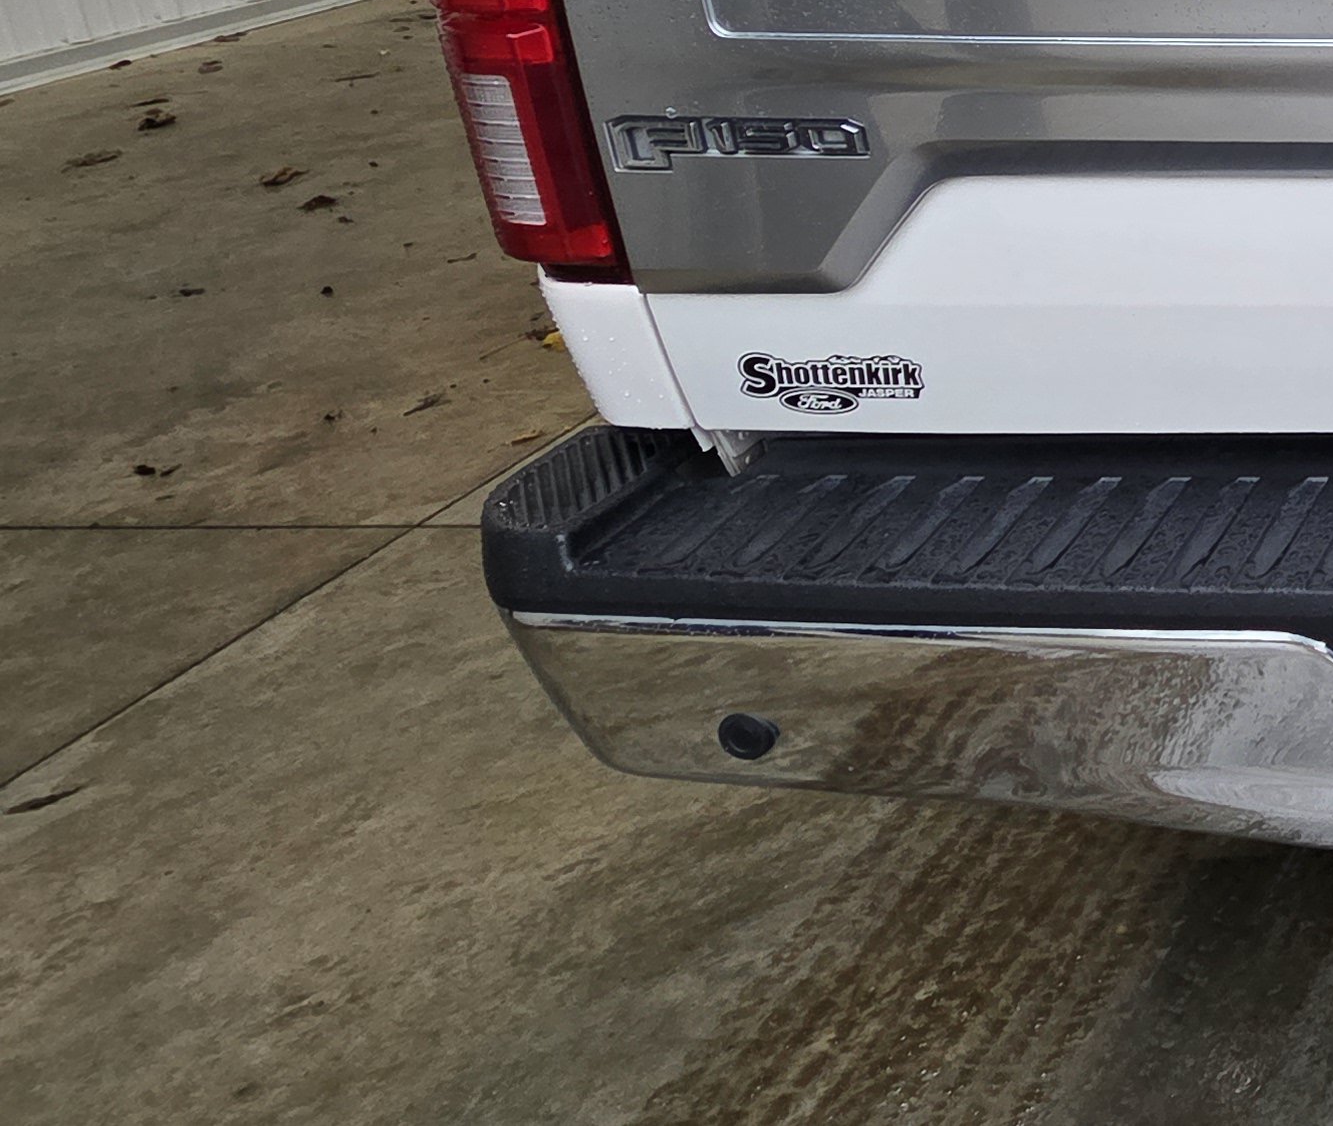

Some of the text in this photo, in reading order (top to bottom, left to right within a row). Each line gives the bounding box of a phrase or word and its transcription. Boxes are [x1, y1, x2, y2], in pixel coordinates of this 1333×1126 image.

[739, 353, 923, 397] Shottenkirk
[858, 387, 915, 398] JASPER
[797, 394, 843, 410] Ford
